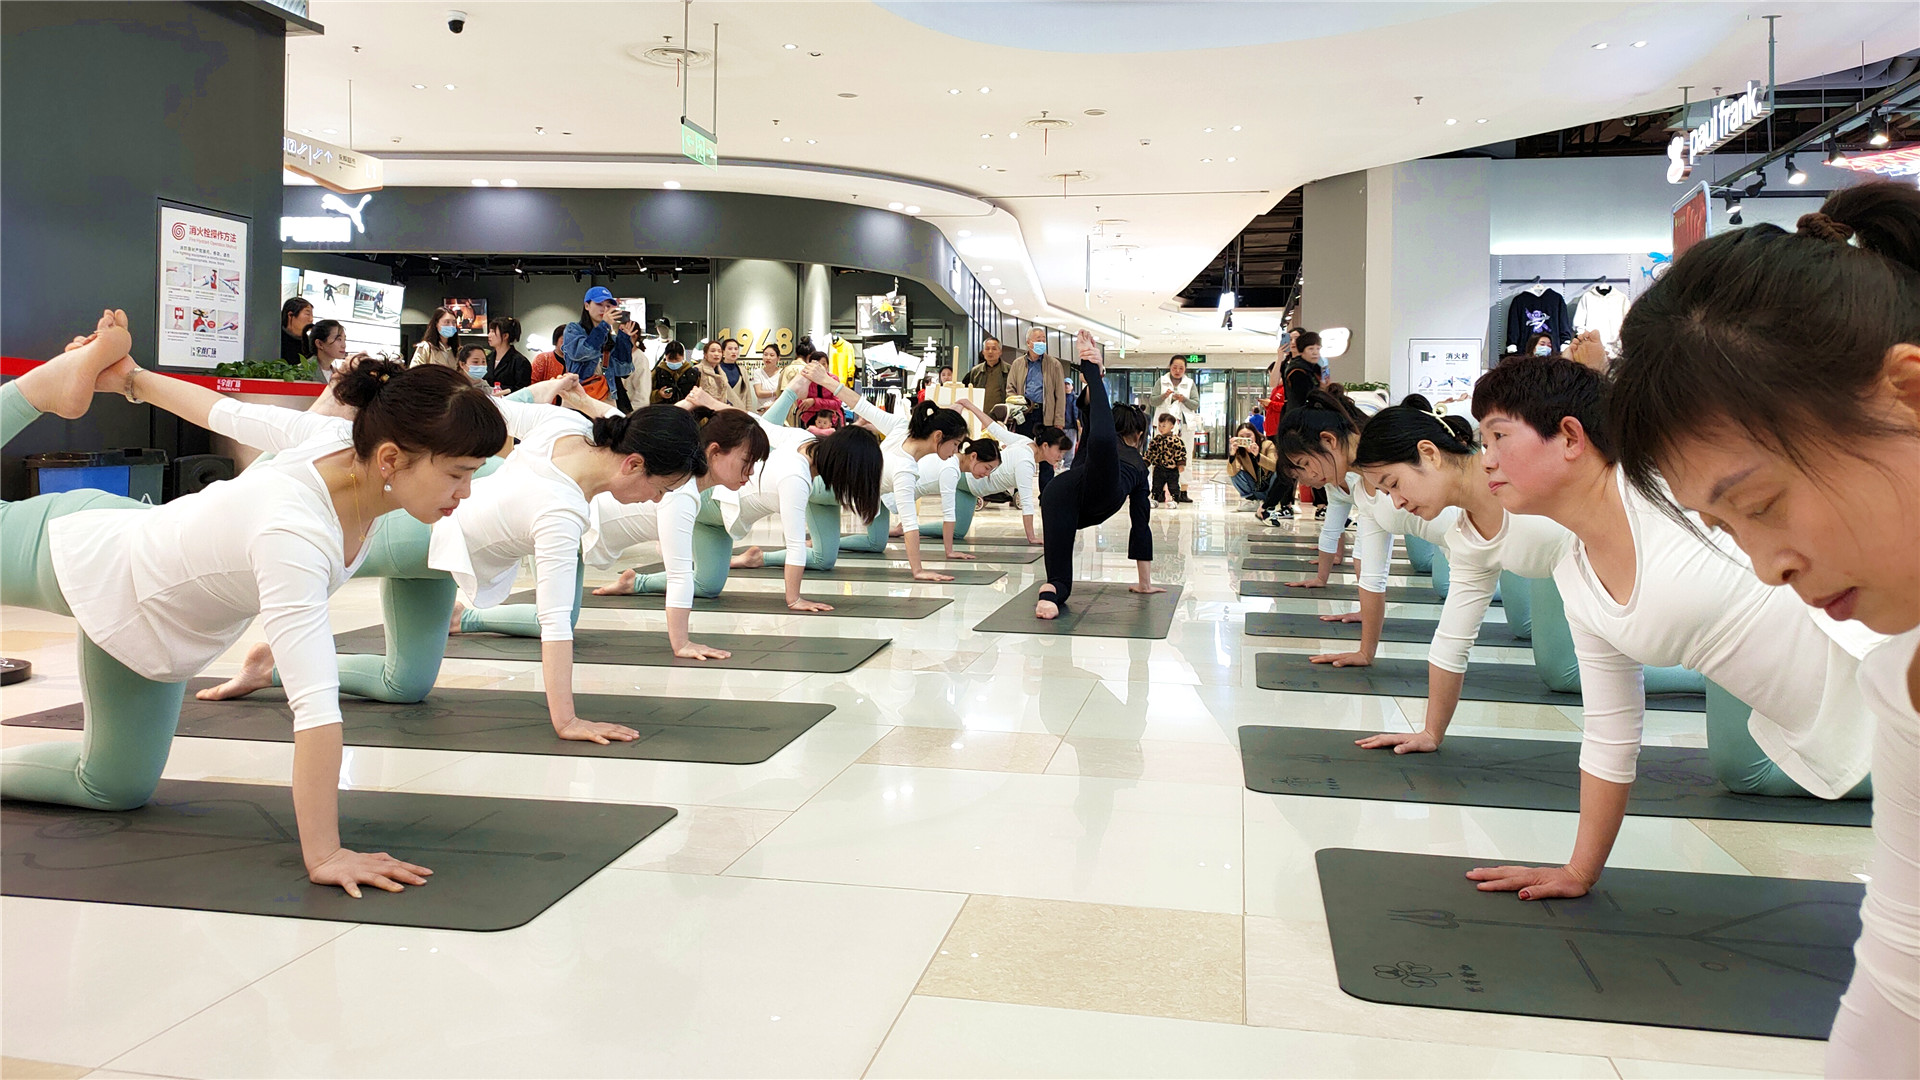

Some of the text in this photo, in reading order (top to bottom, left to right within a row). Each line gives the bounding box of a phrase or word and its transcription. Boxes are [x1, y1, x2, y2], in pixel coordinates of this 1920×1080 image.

[1689, 104, 1718, 165] paul
[188, 225, 237, 243] 消火栓操作方法
[1445, 352, 1469, 360] 消火栓
